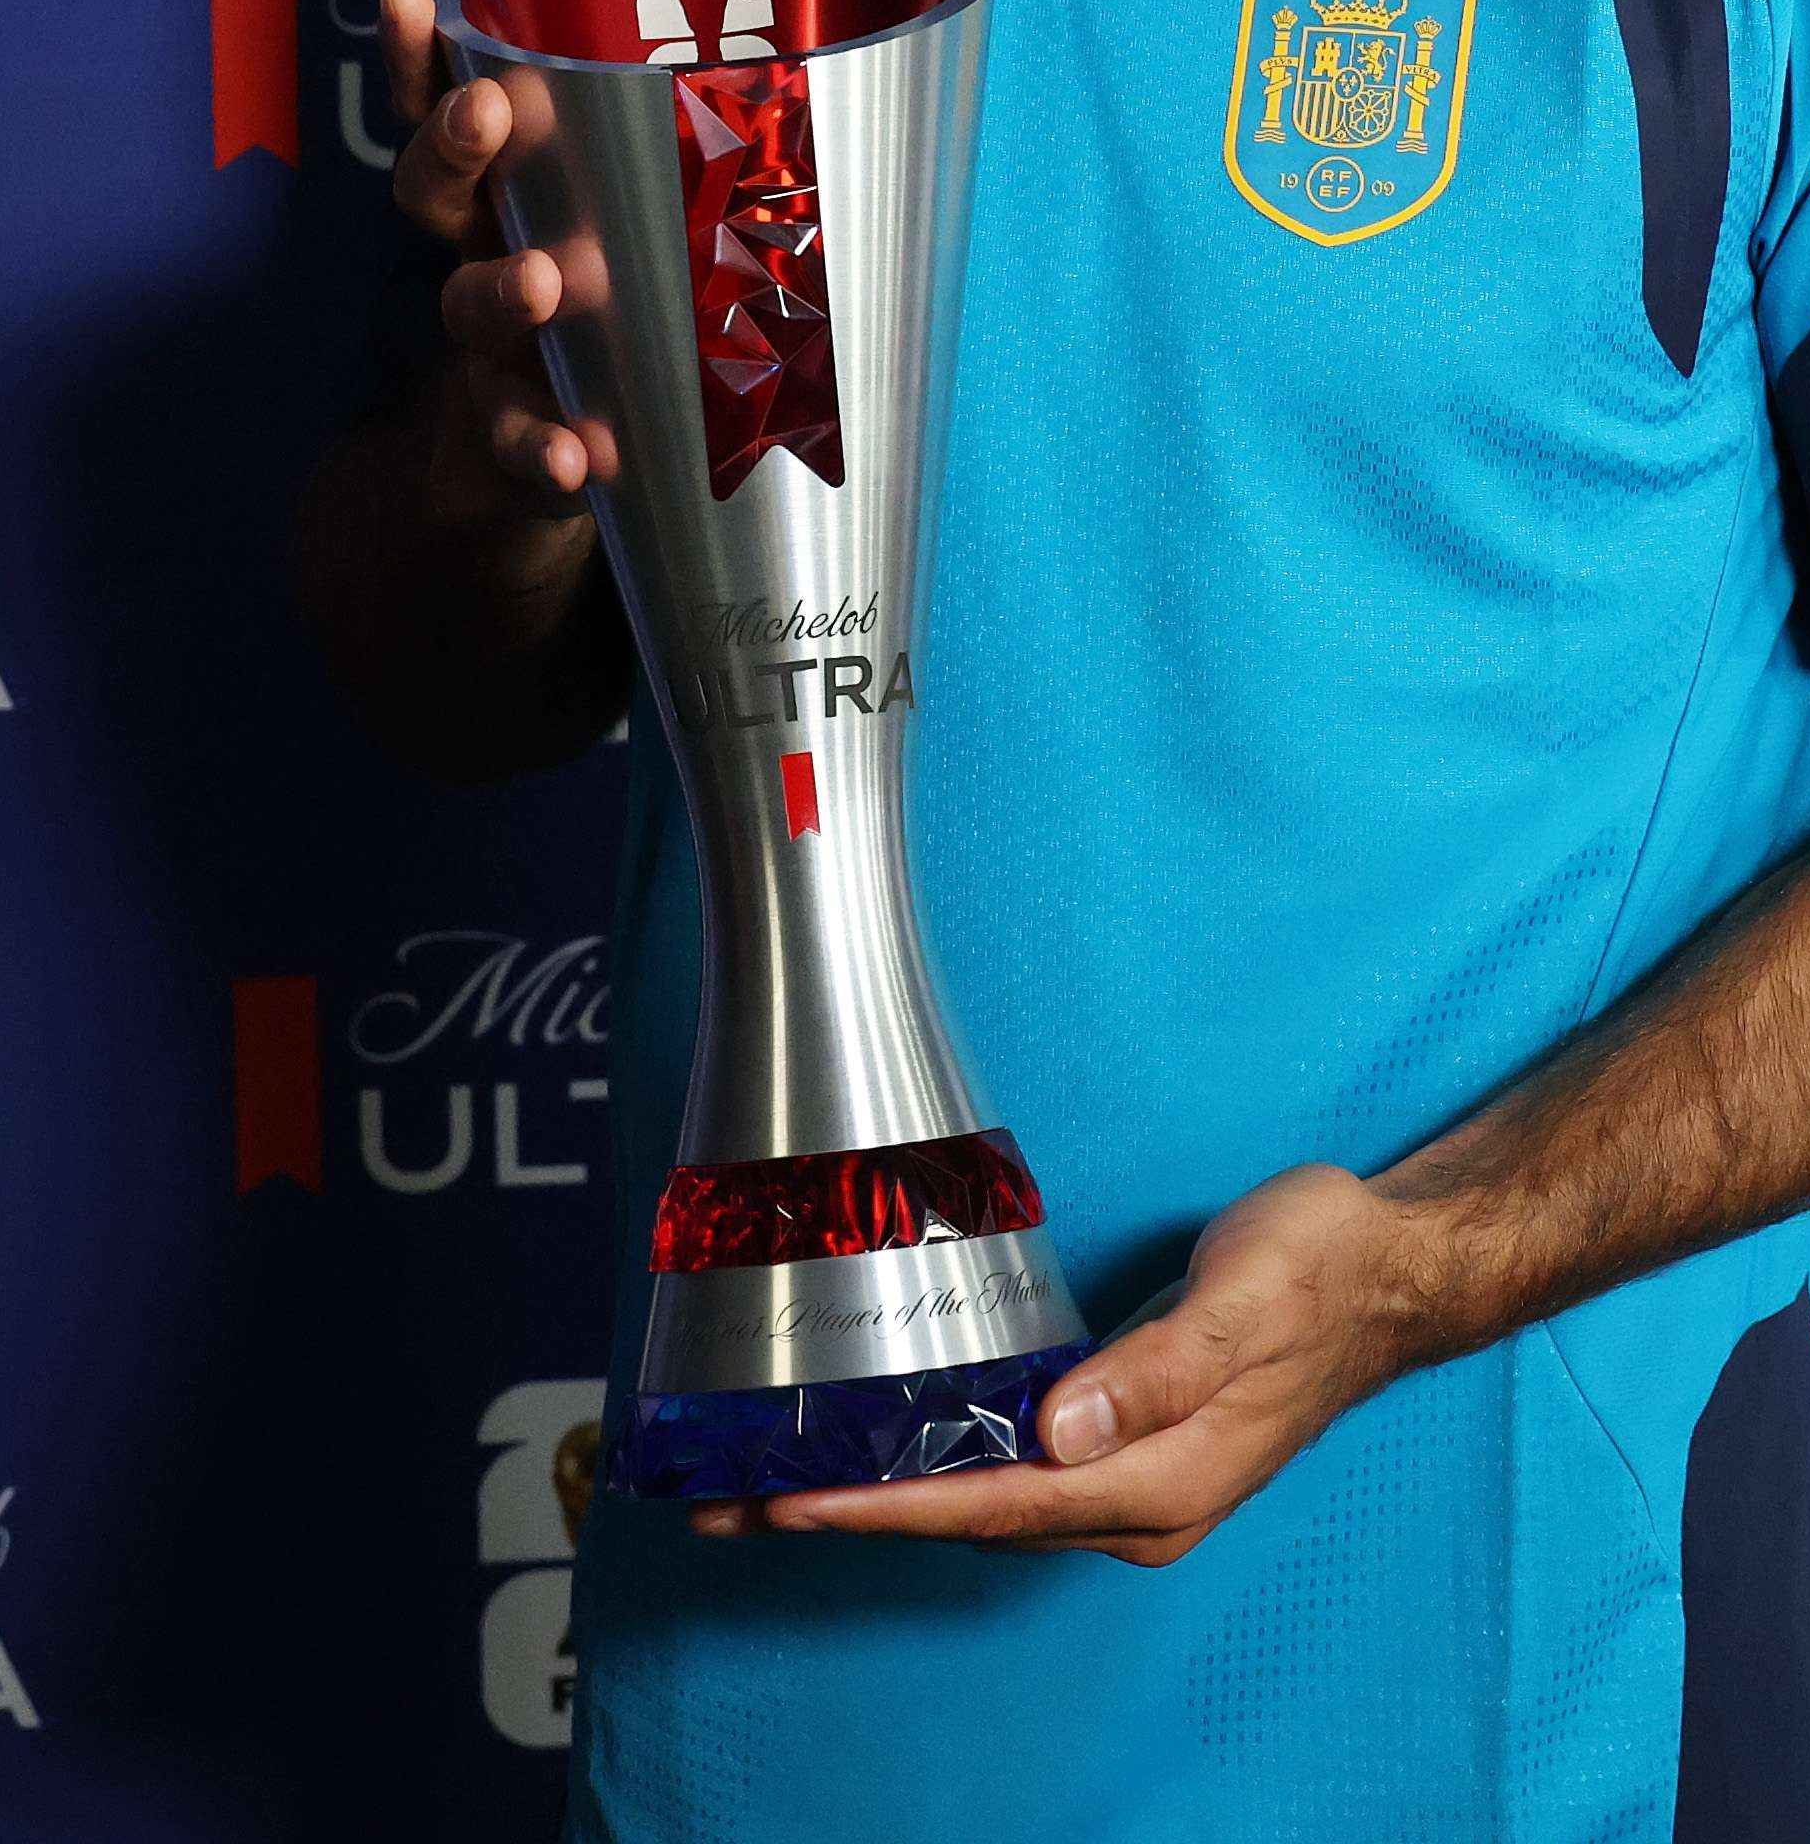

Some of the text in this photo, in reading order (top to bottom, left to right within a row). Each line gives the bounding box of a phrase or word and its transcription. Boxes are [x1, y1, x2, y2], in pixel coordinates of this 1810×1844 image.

[769, 1299, 886, 1343] Player
[892, 1286, 927, 1338] of
[928, 1287, 971, 1317] the
[976, 1270, 1052, 1316] Match
